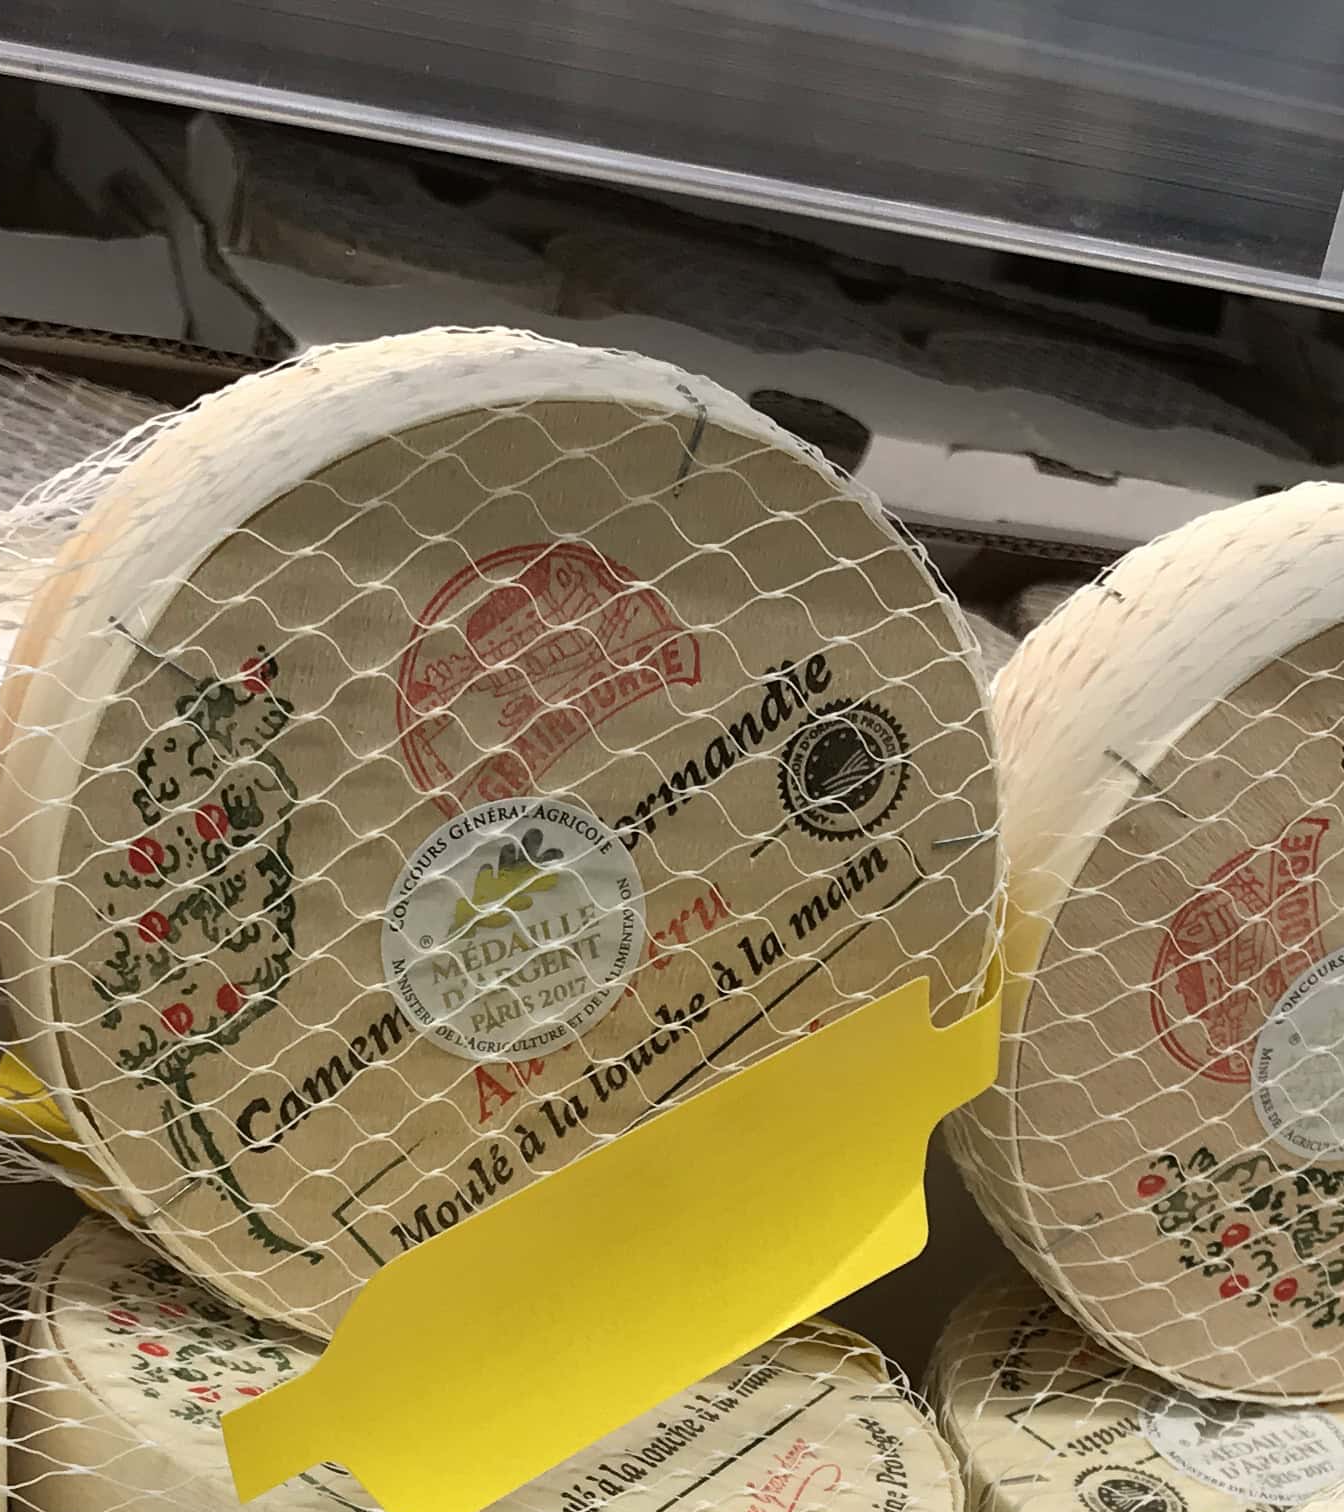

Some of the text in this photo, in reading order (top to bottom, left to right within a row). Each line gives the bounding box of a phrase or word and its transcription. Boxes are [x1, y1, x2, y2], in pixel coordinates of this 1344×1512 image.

[616, 650, 834, 854] ormandie
[650, 882, 735, 976] cru
[388, 1138, 516, 1254] Moulé
[539, 1088, 590, 1140] la
[582, 990, 712, 1116] louche
[714, 957, 750, 1005] à
[740, 927, 786, 970] la
[786, 846, 890, 950] main
[471, 976, 589, 1036] PARIS 2017
[598, 1463, 649, 1485] la
